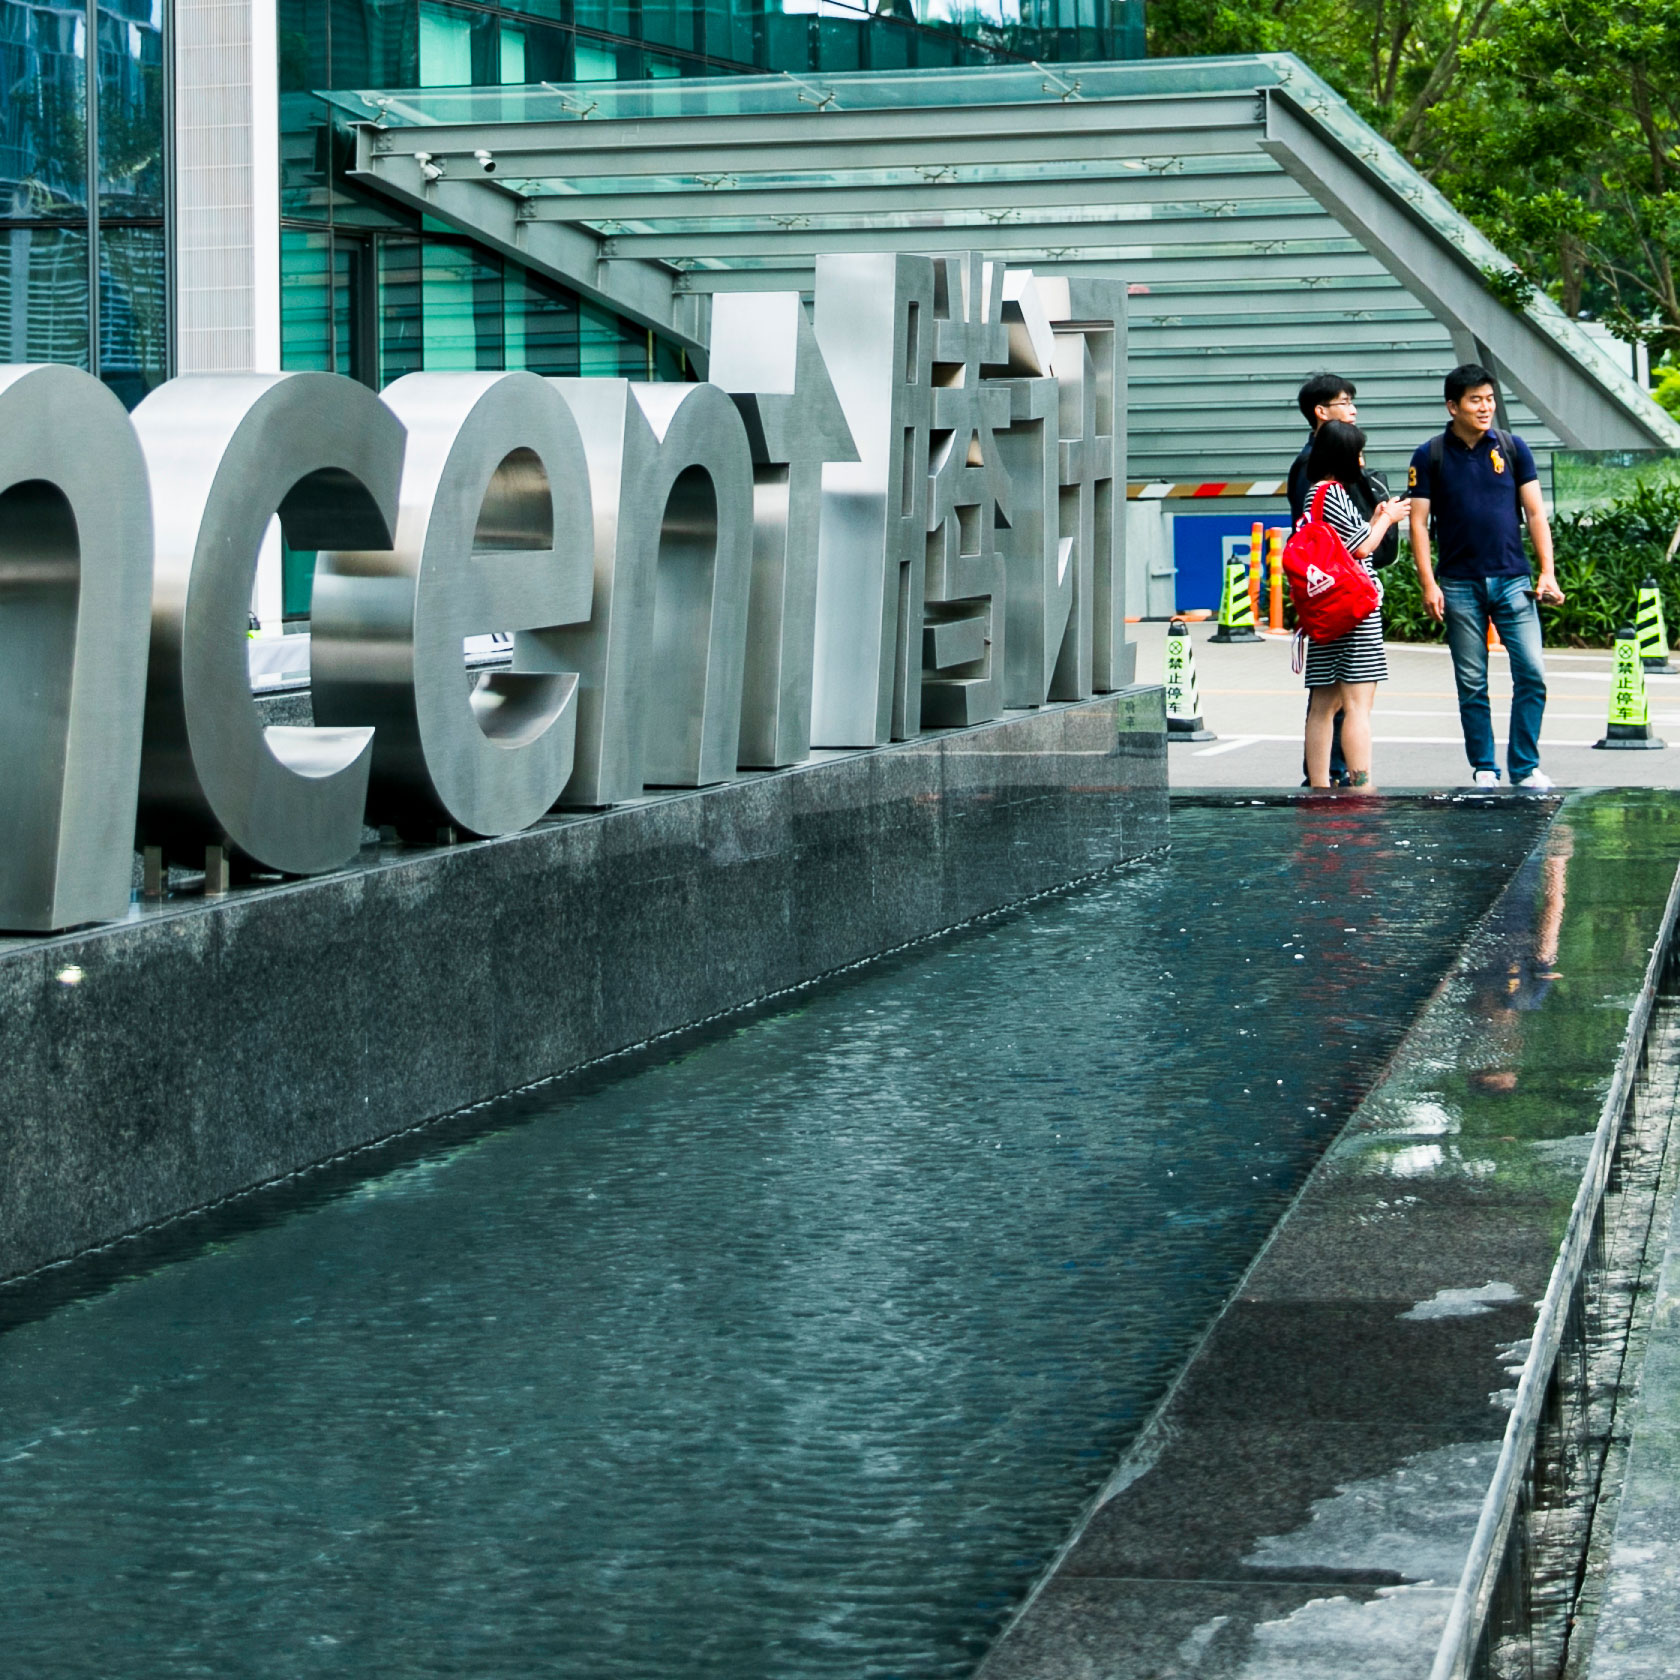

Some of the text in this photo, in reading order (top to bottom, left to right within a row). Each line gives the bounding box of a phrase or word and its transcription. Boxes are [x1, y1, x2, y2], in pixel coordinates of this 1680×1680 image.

[810, 252, 1135, 747] 腾讯
[1408, 467, 1418, 487] 3
[1167, 658, 1183, 713] 禁止停车
[1616, 662, 1634, 720] 禁止停车
